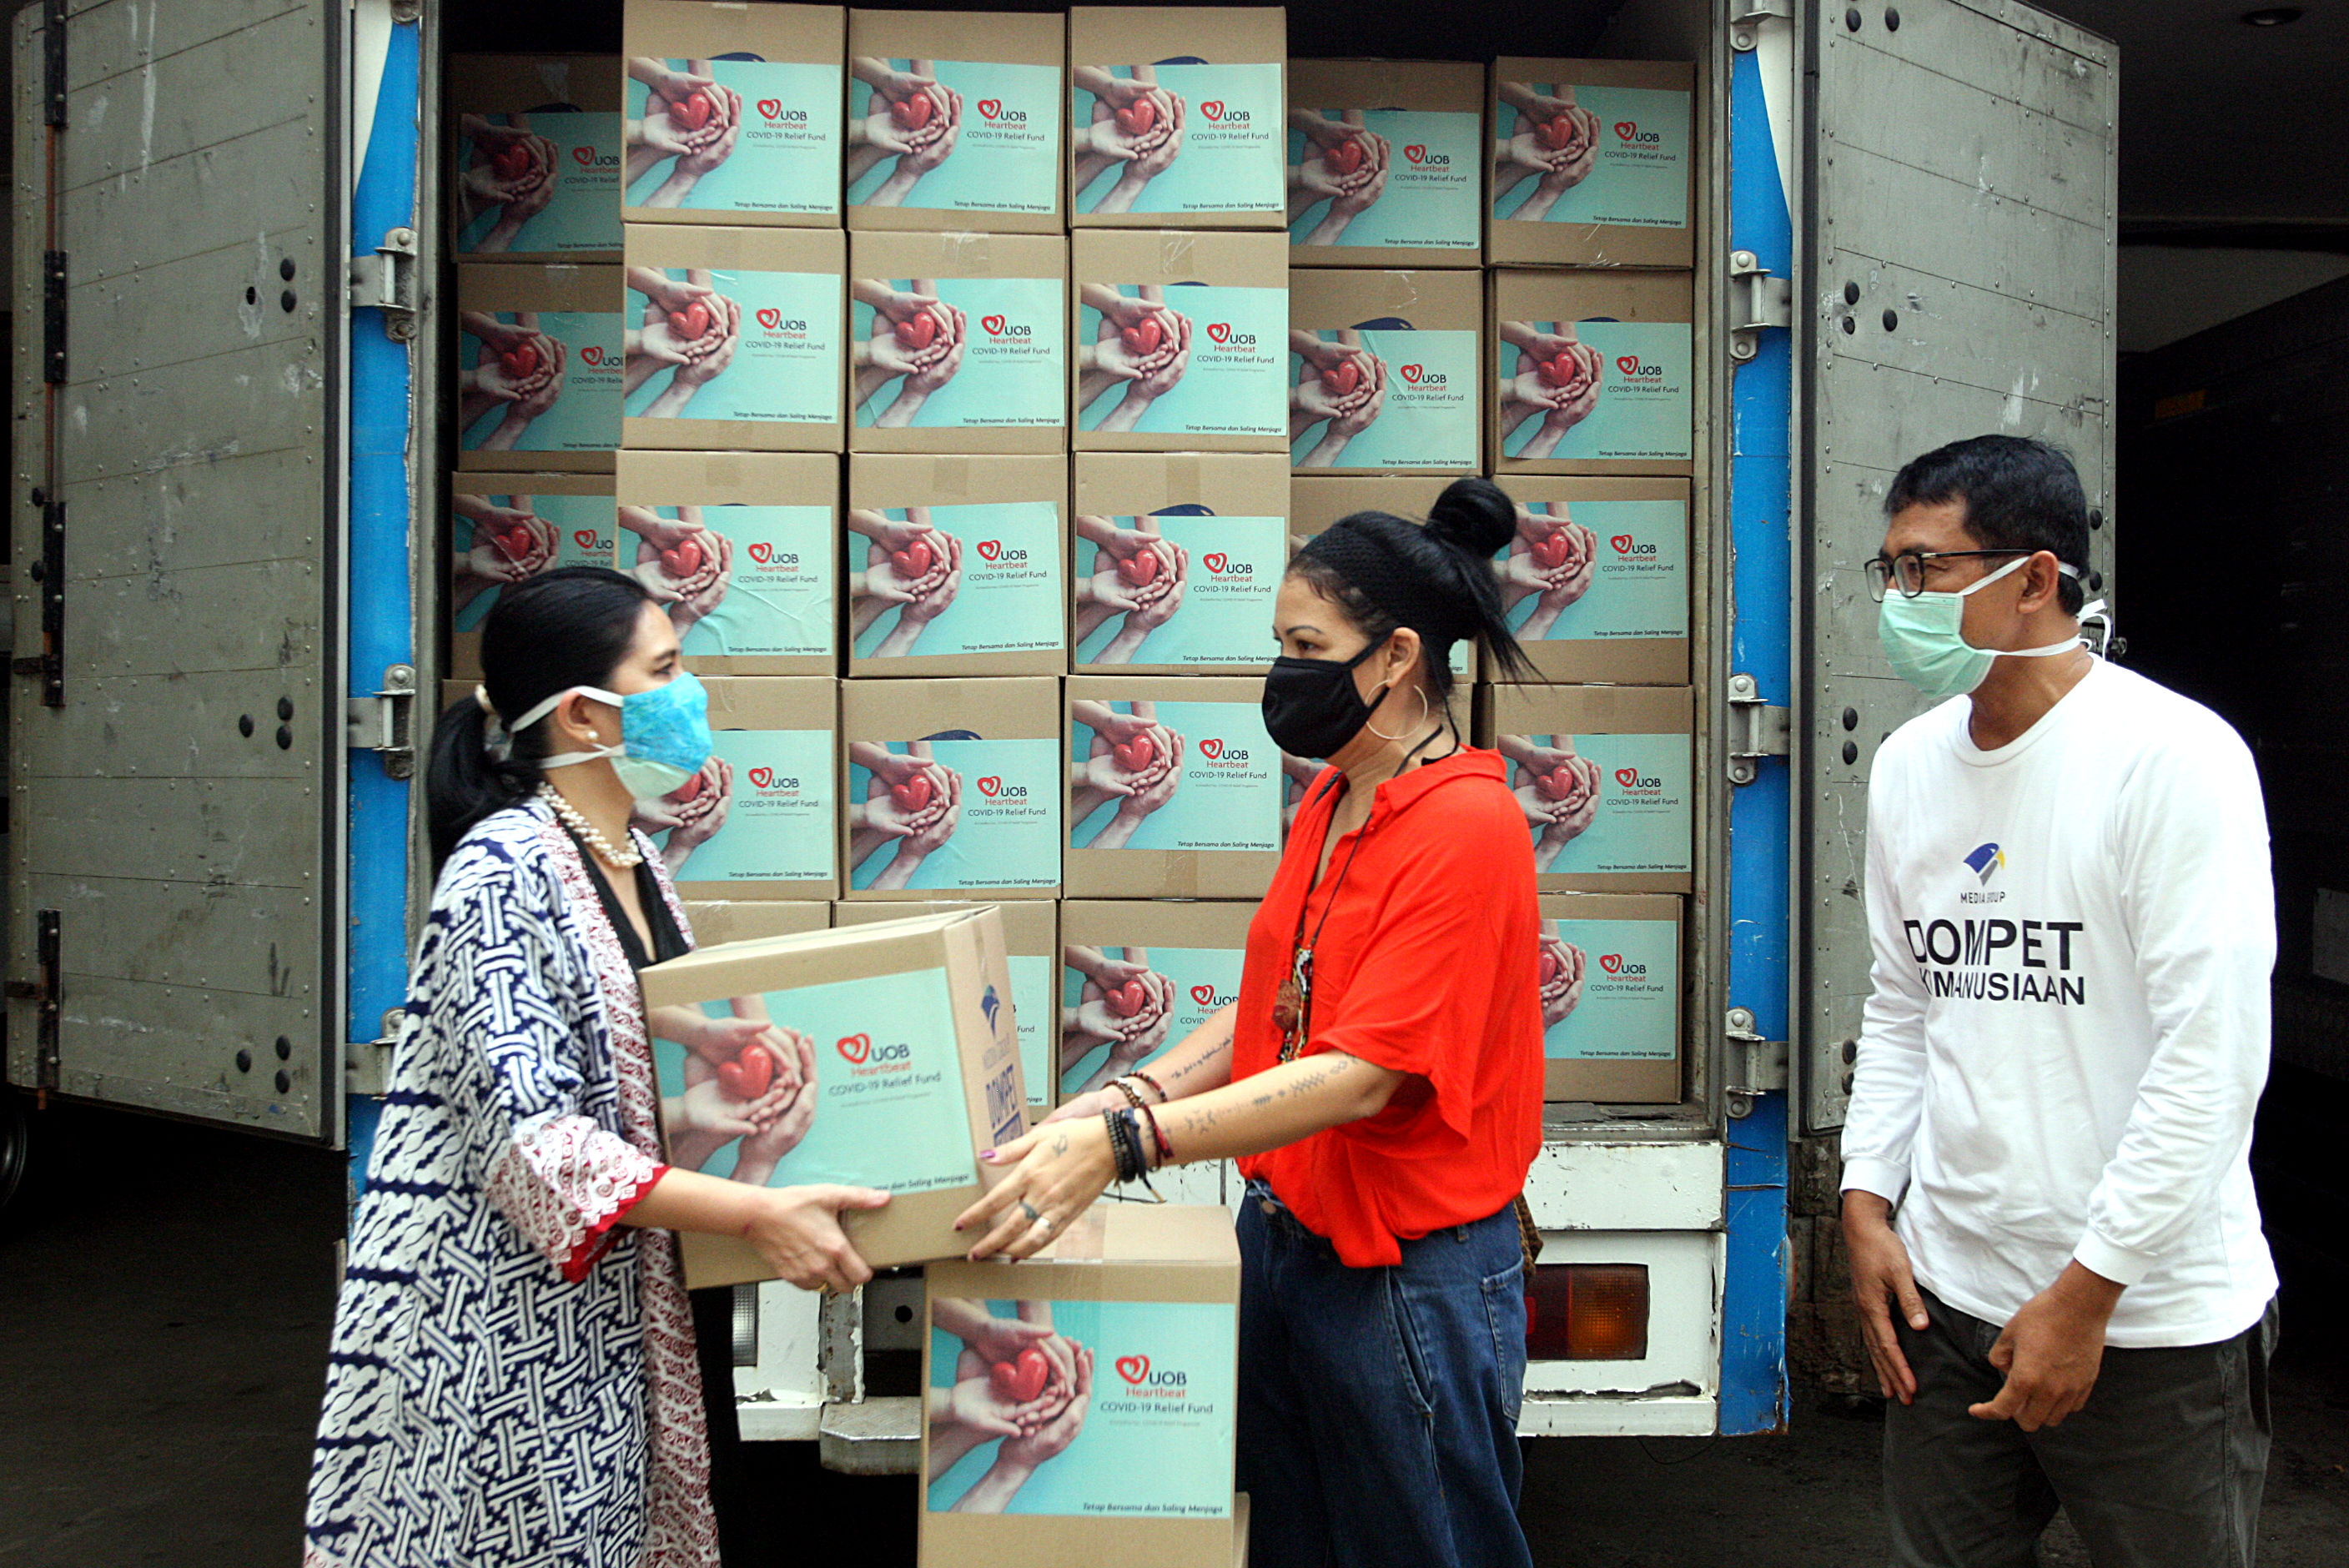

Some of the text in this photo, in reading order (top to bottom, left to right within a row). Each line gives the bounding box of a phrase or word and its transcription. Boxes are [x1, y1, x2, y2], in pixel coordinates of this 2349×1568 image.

[780, 110, 807, 120] UOB
[1000, 110, 1027, 121] UOB
[1223, 111, 1250, 121] UOB
[983, 120, 1026, 129] Heartbeat
[1208, 121, 1250, 129] Heartbeat
[746, 131, 782, 139] COVID-19
[966, 130, 1002, 139] COVID-19
[1003, 132, 1025, 140] Relief
[1635, 132, 1659, 142] UOB
[1620, 141, 1658, 150] Heartbeat
[1425, 154, 1450, 163] UOB
[1604, 150, 1637, 158] COVID-19
[595, 156, 620, 165] UOB
[779, 319, 807, 330] UOB
[1004, 325, 1031, 335] UOB
[988, 335, 1030, 344] Heartbeat
[1230, 334, 1255, 344] UOB
[745, 340, 782, 349] COVID-19
[783, 341, 805, 349] Relief
[1214, 344, 1255, 353] Heartbeat
[1637, 365, 1662, 374] UOB
[1421, 374, 1446, 383] UOB
[596, 540, 614, 549] UO
[1632, 544, 1656, 554] UOB
[772, 553, 798, 563] UOB
[1000, 549, 1027, 560] UOB
[985, 560, 1027, 570] Heartbeat
[1226, 564, 1252, 573] UOB
[968, 572, 1004, 580] COVID-19
[1006, 570, 1027, 579] Relief
[1210, 574, 1252, 582] Heartbeat
[1222, 750, 1248, 759] UOB
[1206, 760, 1248, 768] Heartbeat
[772, 777, 799, 788] UOB
[1636, 777, 1661, 787] UOB
[1000, 786, 1027, 797] UOB
[984, 797, 1027, 805] Heartbeat
[968, 808, 1003, 817] COVID-19
[1005, 807, 1026, 816] Relief
[1903, 919, 2083, 970] DOMPET
[1621, 964, 1646, 973] UOB
[871, 1043, 910, 1062] UOB
[827, 1072, 941, 1097] COVID-19 Relief Fund
[1149, 1371, 1187, 1385] UOB
[1125, 1386, 1185, 1398] Heartbeat
[1099, 1401, 1213, 1414] COVID-19 Relief Fund
